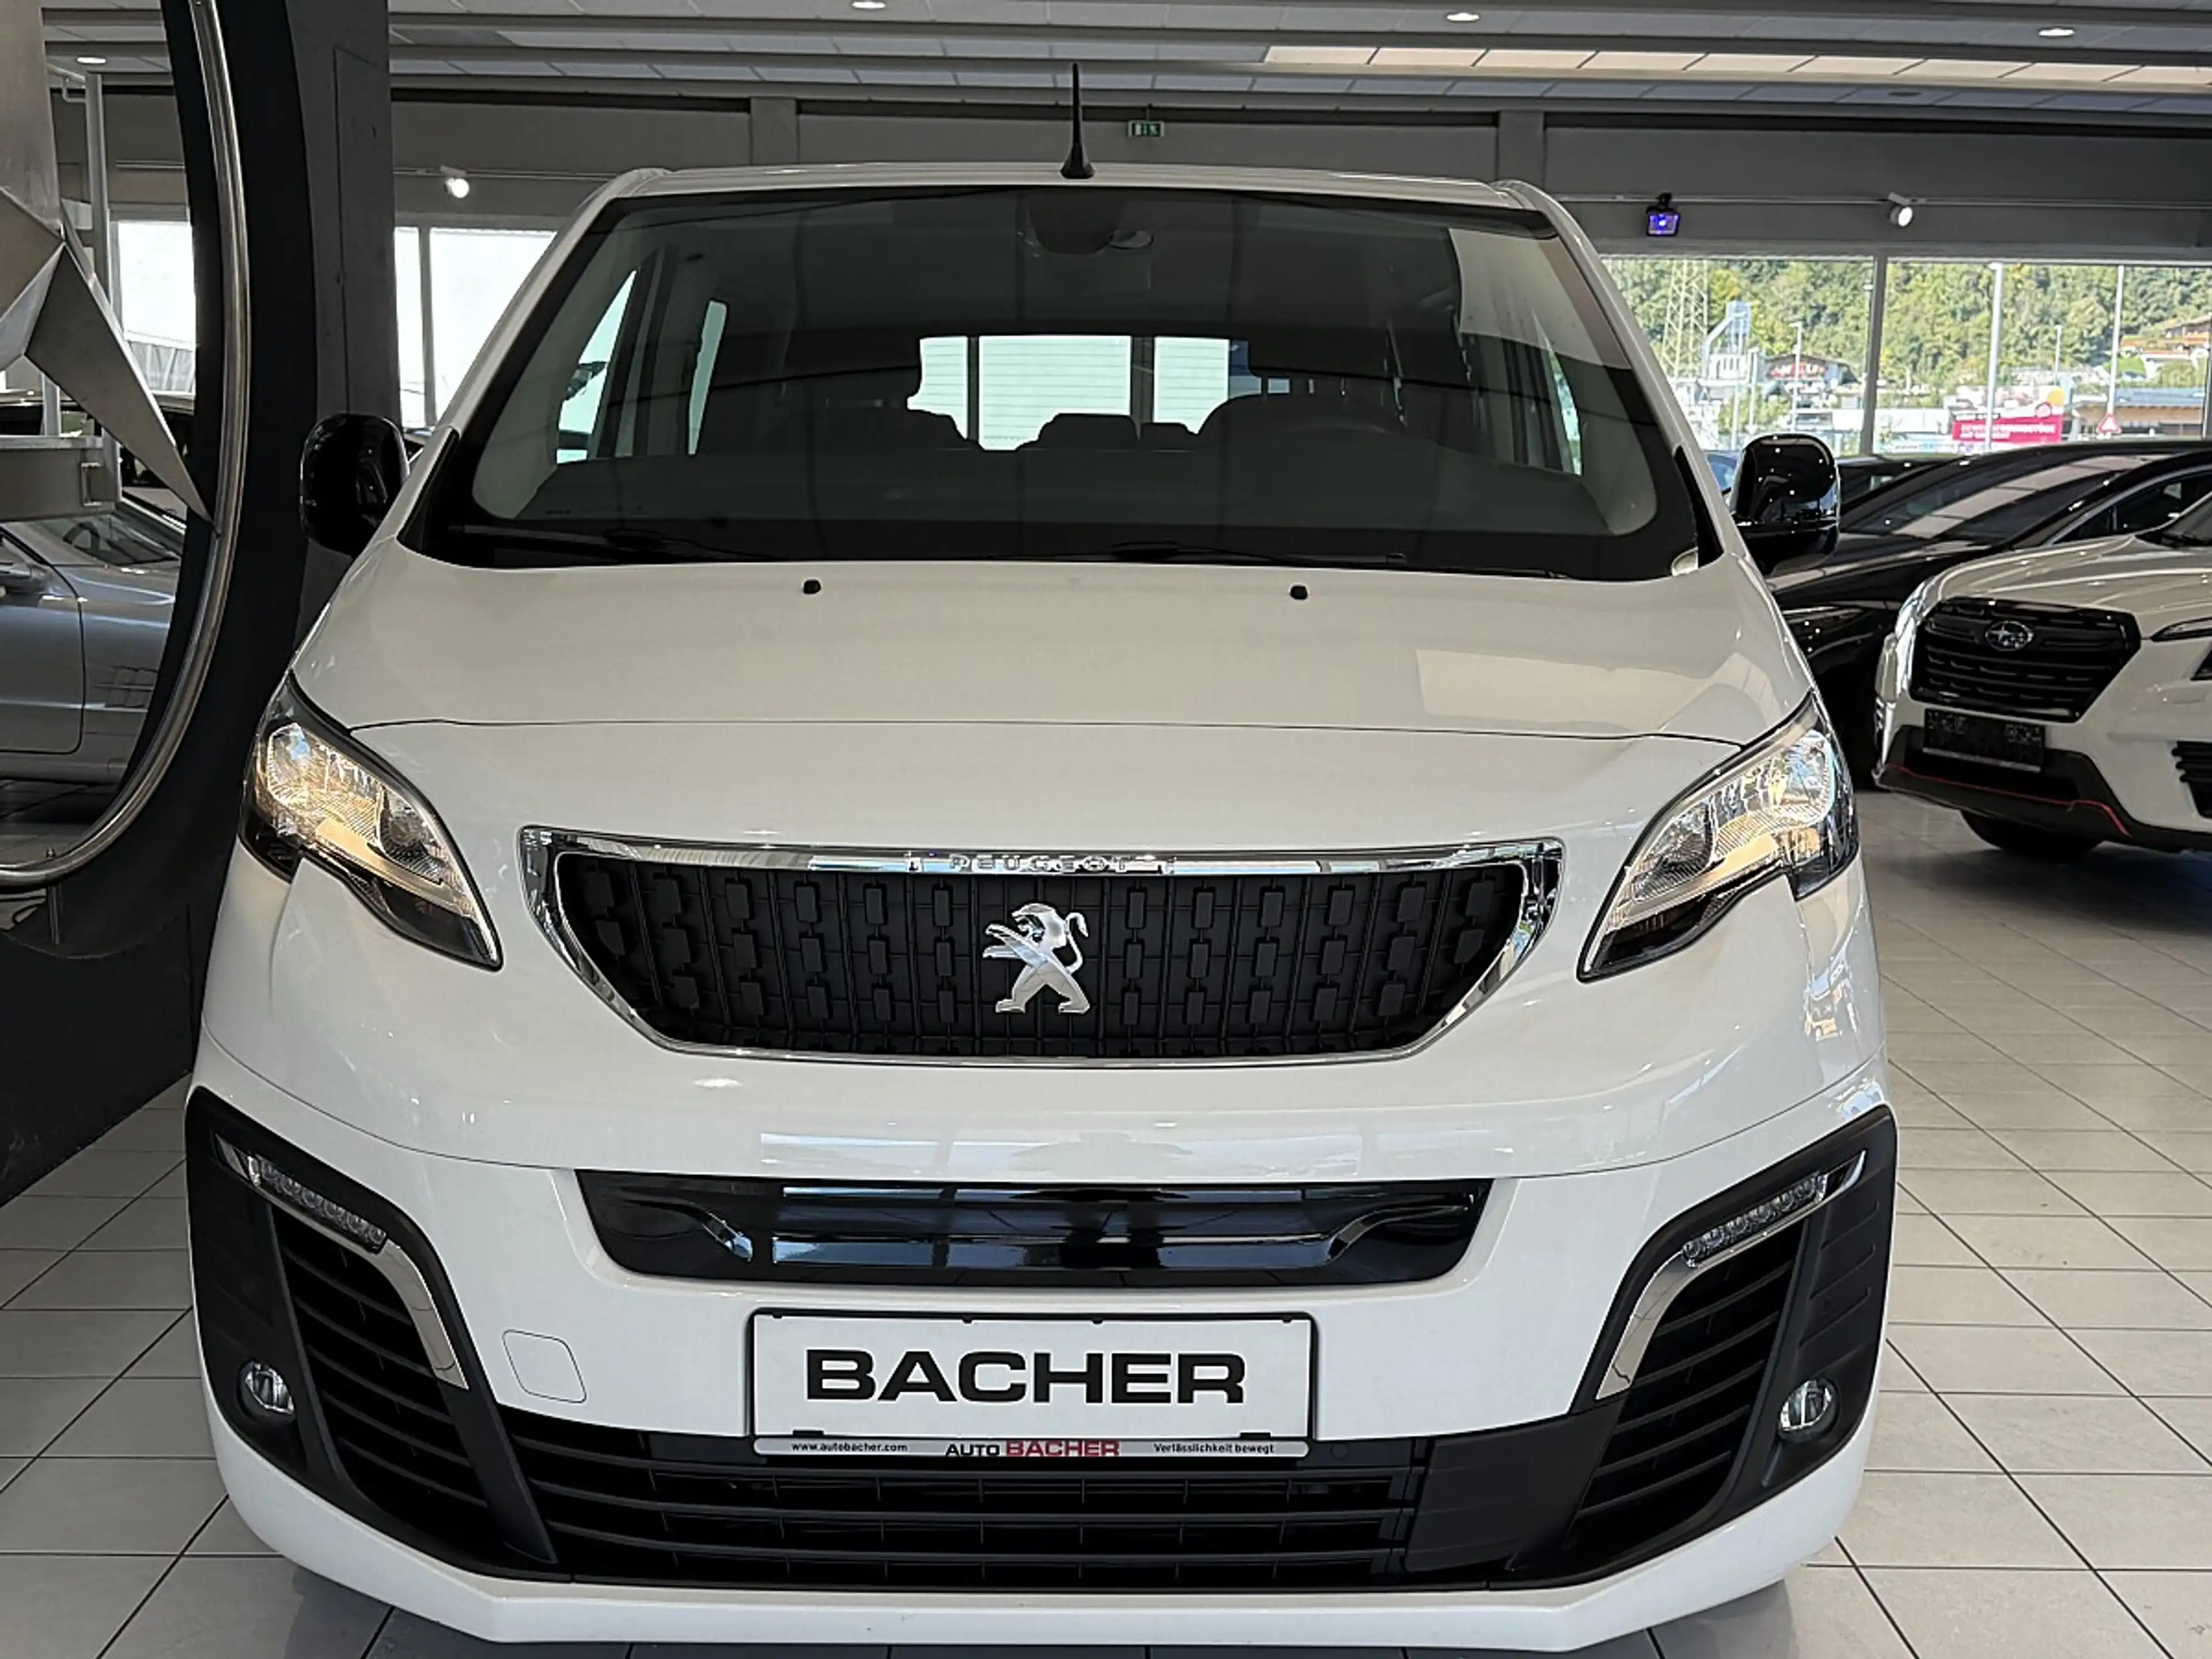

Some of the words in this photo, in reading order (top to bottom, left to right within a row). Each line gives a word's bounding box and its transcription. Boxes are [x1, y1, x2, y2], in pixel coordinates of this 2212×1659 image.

[949, 853, 1130, 873] PEUGEOT
[806, 1349, 1245, 1404] BACHER
[791, 1442, 907, 1453] www.autobacher.com
[945, 1444, 1001, 1457] AUTO
[1006, 1440, 1120, 1458] BACHER
[1154, 1442, 1233, 1454] Verlässlichkeit
[1236, 1443, 1275, 1455] bewegt
